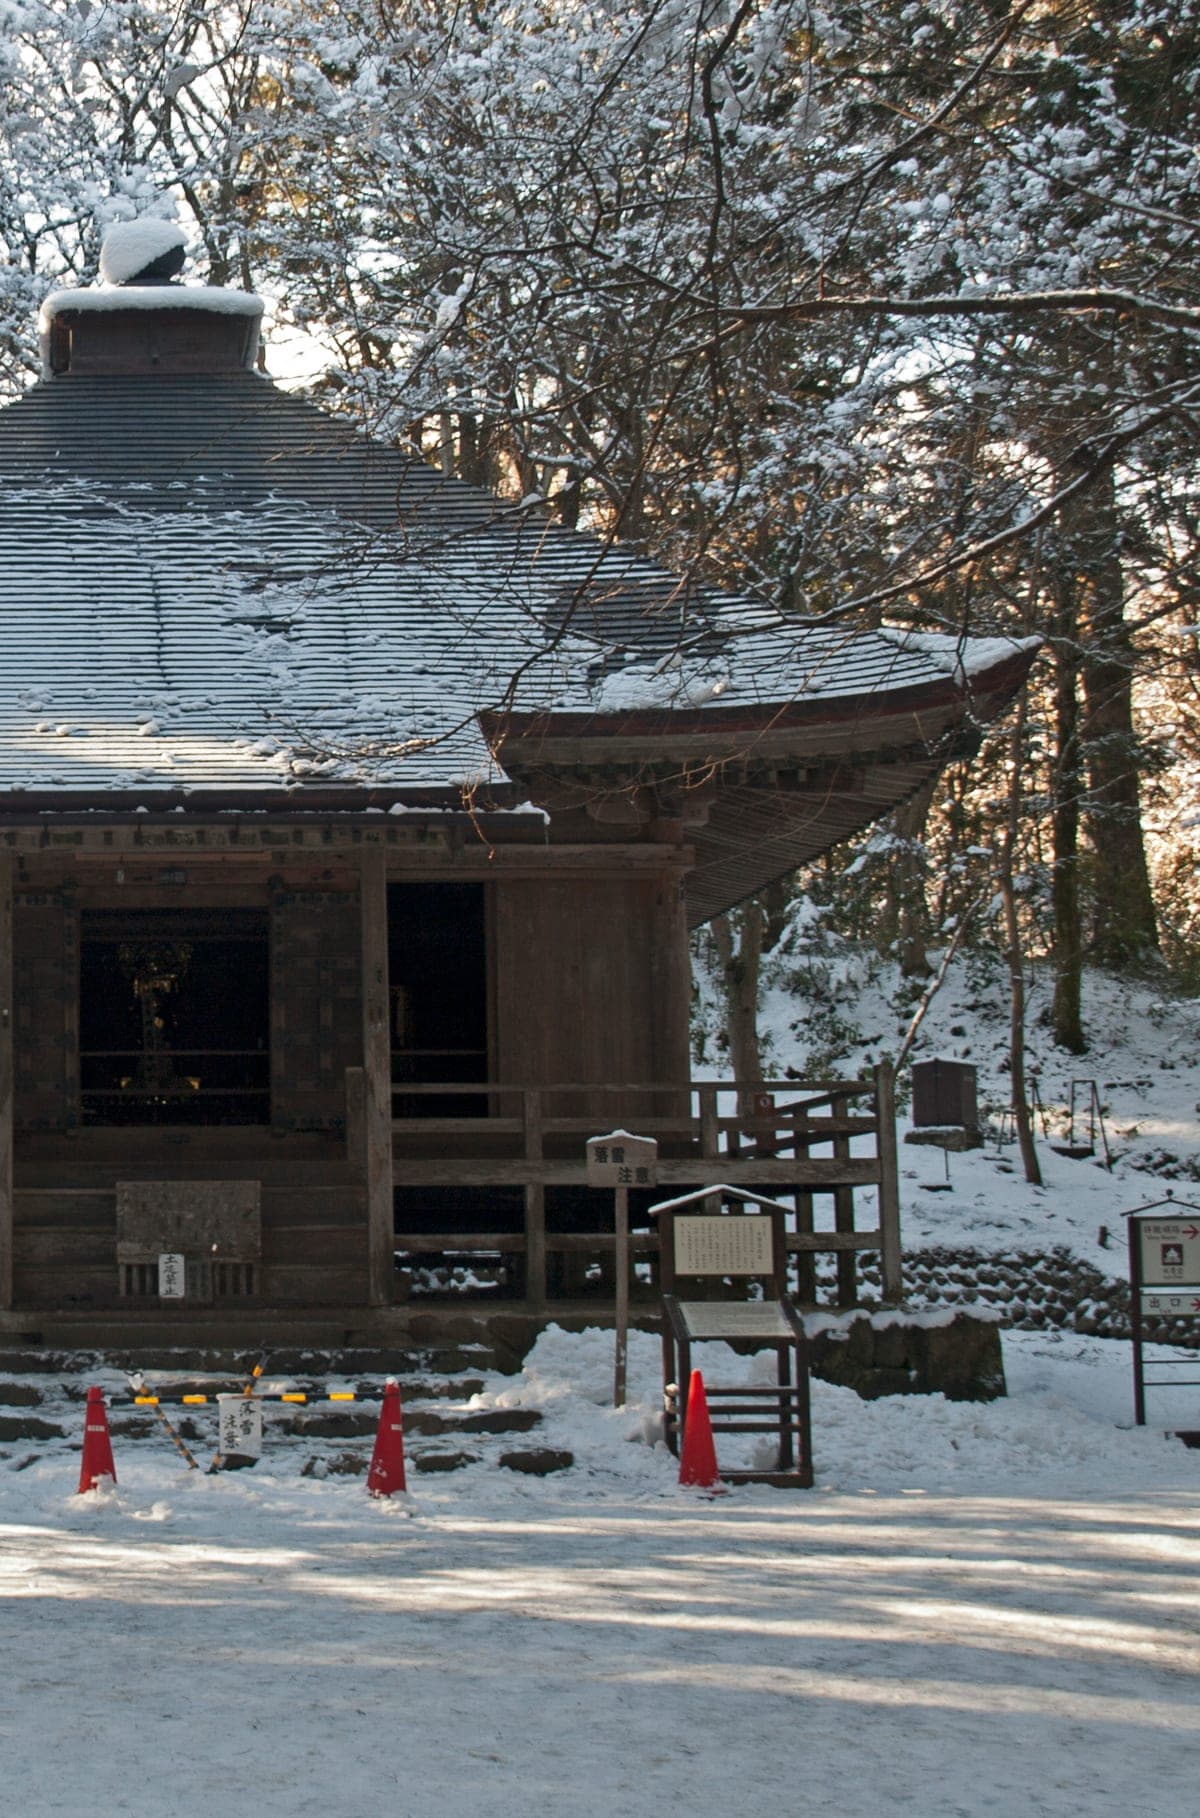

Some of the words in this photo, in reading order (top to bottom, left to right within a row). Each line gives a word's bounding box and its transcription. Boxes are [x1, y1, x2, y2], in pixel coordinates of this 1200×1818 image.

[593, 1145, 625, 1164] 落雪
[618, 1166, 650, 1184] 注意
[163, 1255, 179, 1297] 土足禁止
[1149, 1297, 1182, 1309] 出口
[239, 1400, 256, 1436] 落雪
